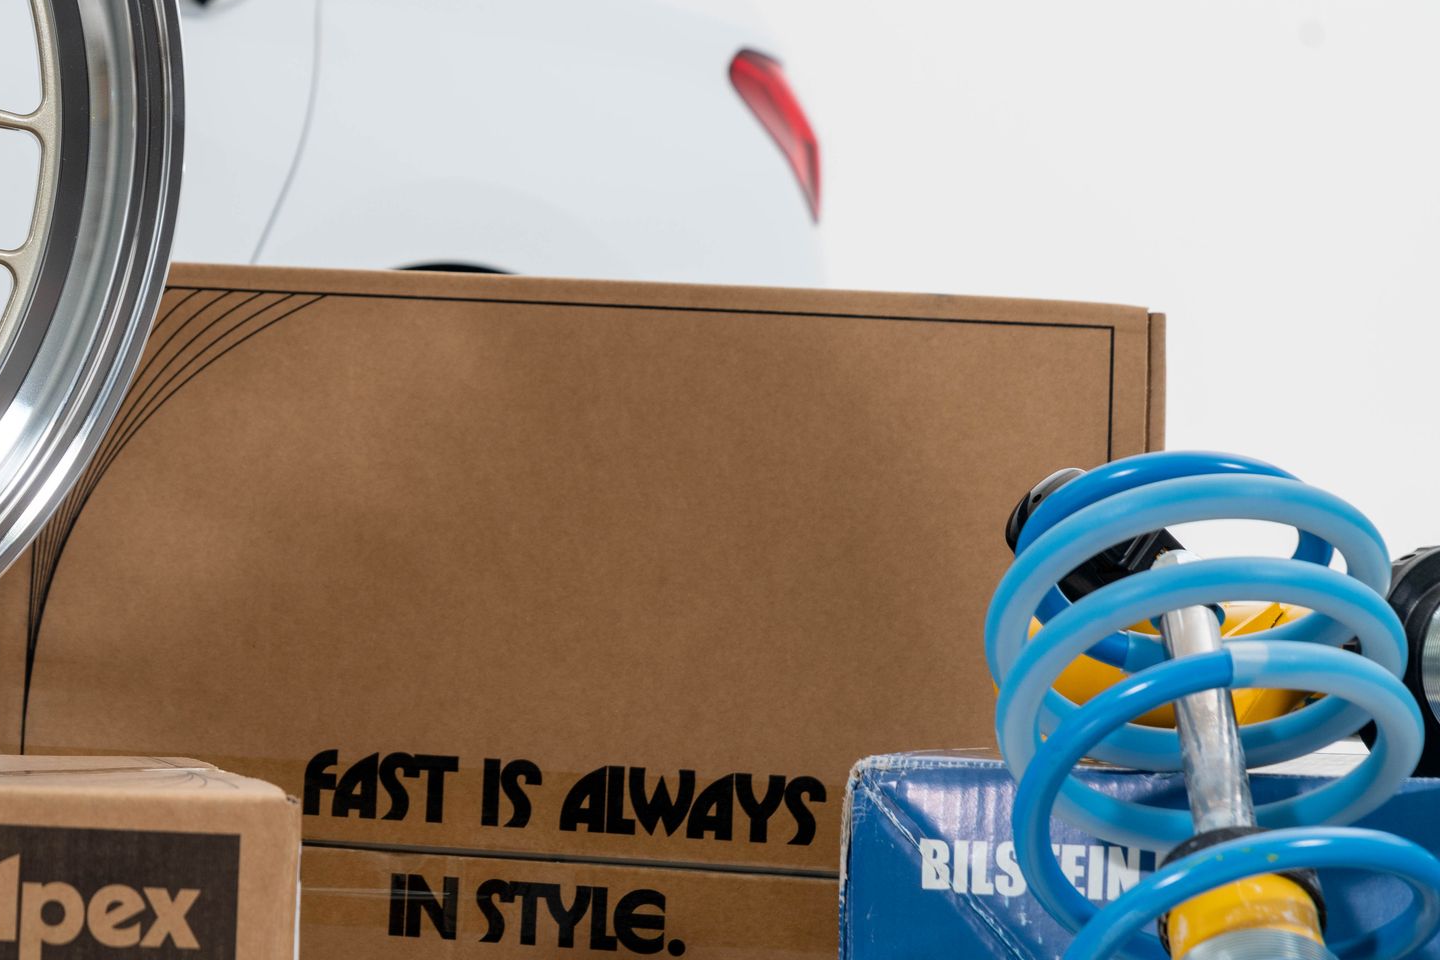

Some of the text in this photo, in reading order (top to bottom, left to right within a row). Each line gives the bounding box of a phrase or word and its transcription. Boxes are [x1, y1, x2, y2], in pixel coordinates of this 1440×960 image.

[302, 749, 827, 846] FAST IS ALWAYS
[920, 838, 1141, 901] BILSEIN
[388, 872, 686, 957] IN STYLE.
